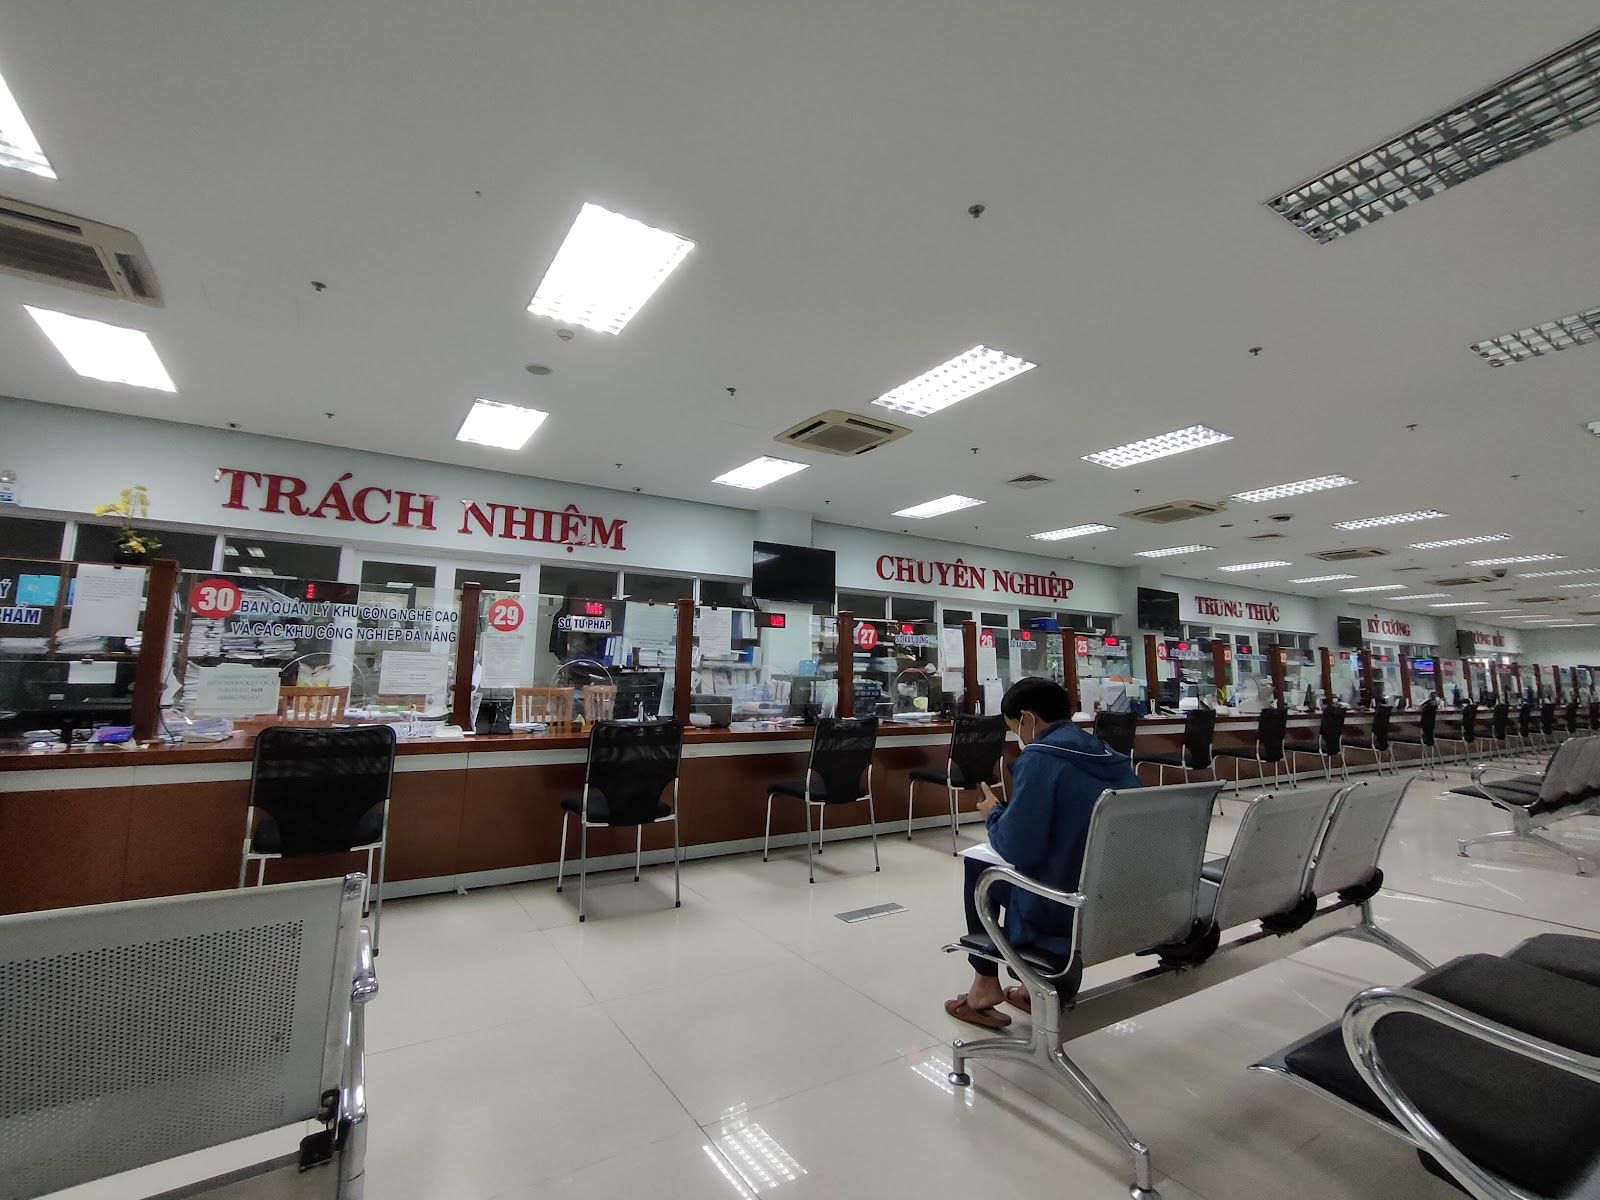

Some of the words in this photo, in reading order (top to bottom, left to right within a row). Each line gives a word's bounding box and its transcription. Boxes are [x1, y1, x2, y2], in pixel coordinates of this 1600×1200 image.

[214, 468, 439, 531] TRÁCH
[458, 499, 628, 553] NHIỆM
[876, 555, 986, 590] CHUYÊN
[992, 569, 1074, 603] NGHIỆP
[198, 586, 235, 612] 30
[1194, 596, 1243, 618] TRUNG
[0, 602, 40, 623] HẨM
[240, 600, 269, 613] BAN
[271, 597, 309, 615] QUẢN
[313, 601, 330, 616] LÝ
[333, 605, 360, 618] KHU
[362, 605, 397, 620] CÔNG
[399, 607, 432, 624] NGHỆ
[434, 610, 458, 623] CAO
[493, 605, 520, 626] 29
[231, 619, 250, 635] VÀ
[252, 620, 283, 637] CÁC
[285, 624, 313, 638] KHU
[316, 623, 353, 639] CÔNG
[356, 626, 403, 644] NGHIỆP
[405, 626, 421, 641] ĐÀ
[860, 628, 875, 644] 27
[981, 634, 994, 649] 26
[1077, 640, 1088, 653] 25
